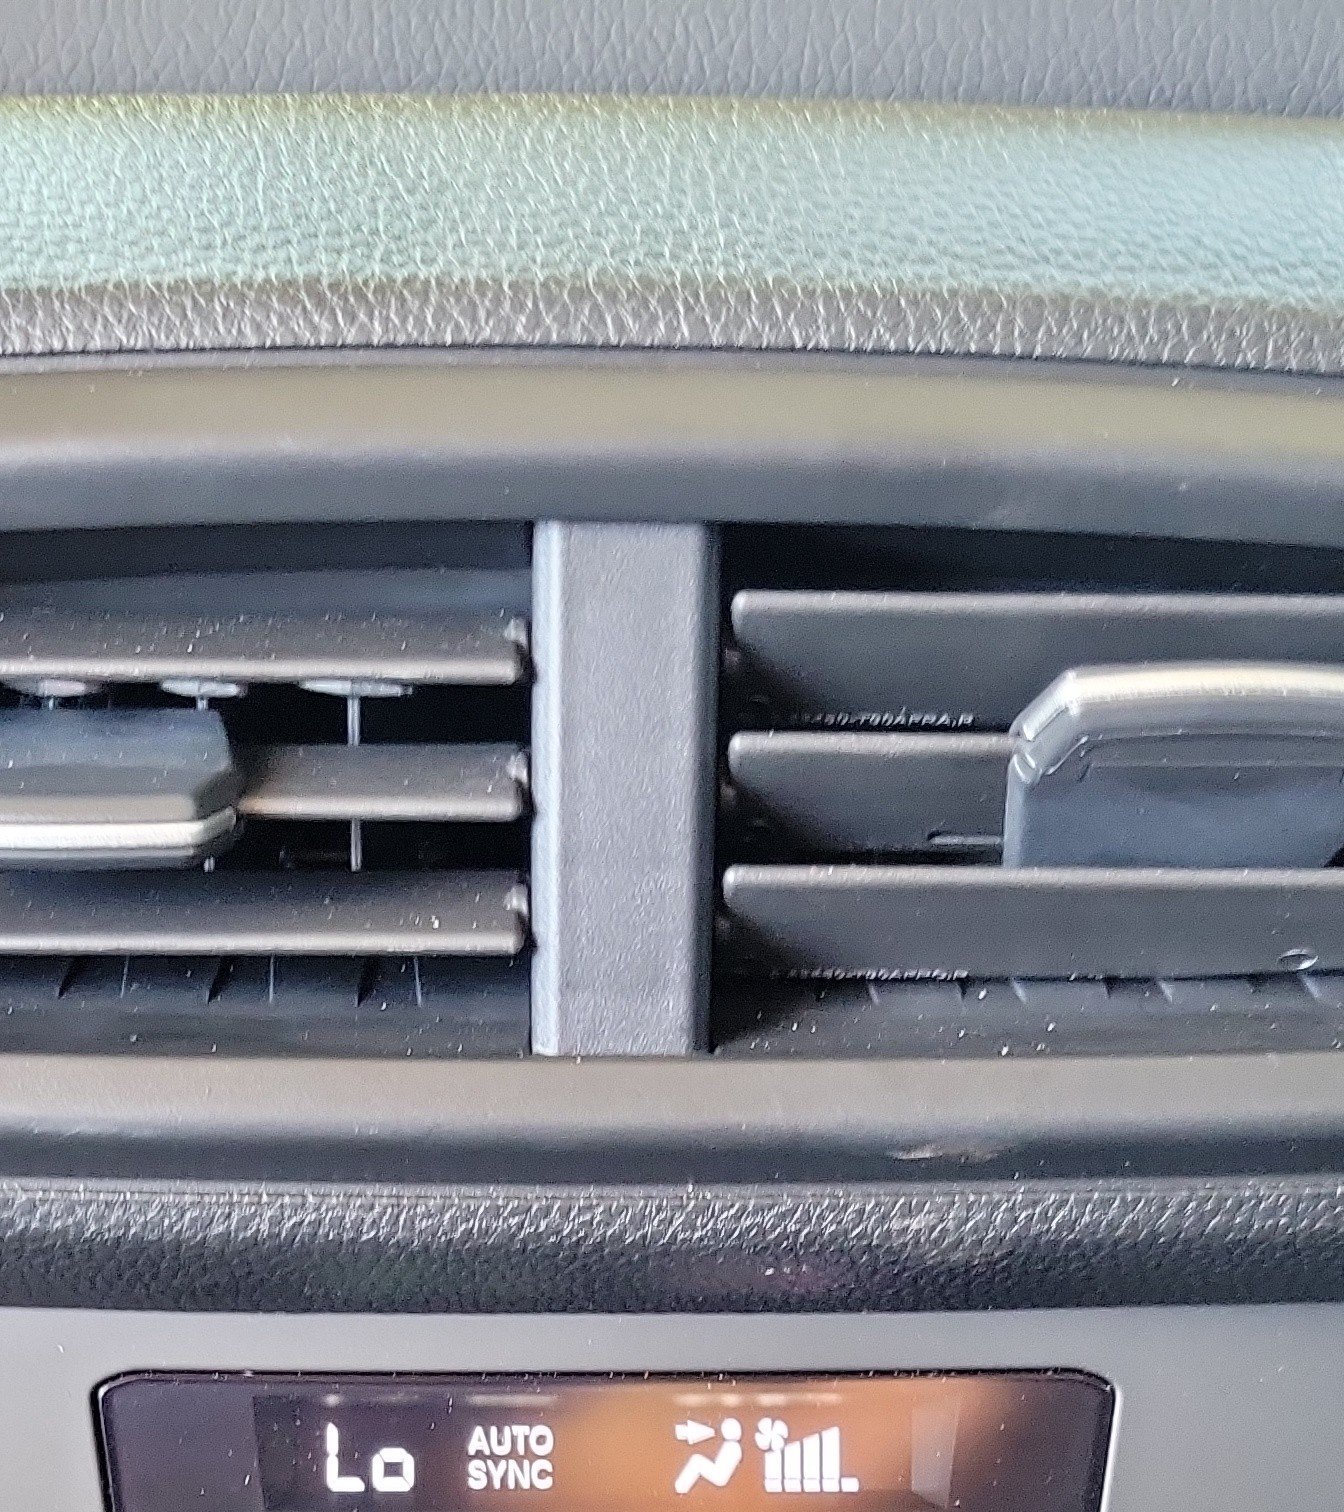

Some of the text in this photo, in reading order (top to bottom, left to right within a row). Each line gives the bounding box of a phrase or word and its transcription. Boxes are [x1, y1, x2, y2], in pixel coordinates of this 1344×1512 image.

[467, 1424, 555, 1456] AUTO
[325, 1421, 416, 1492] Lo
[466, 1459, 554, 1490] SYNC
